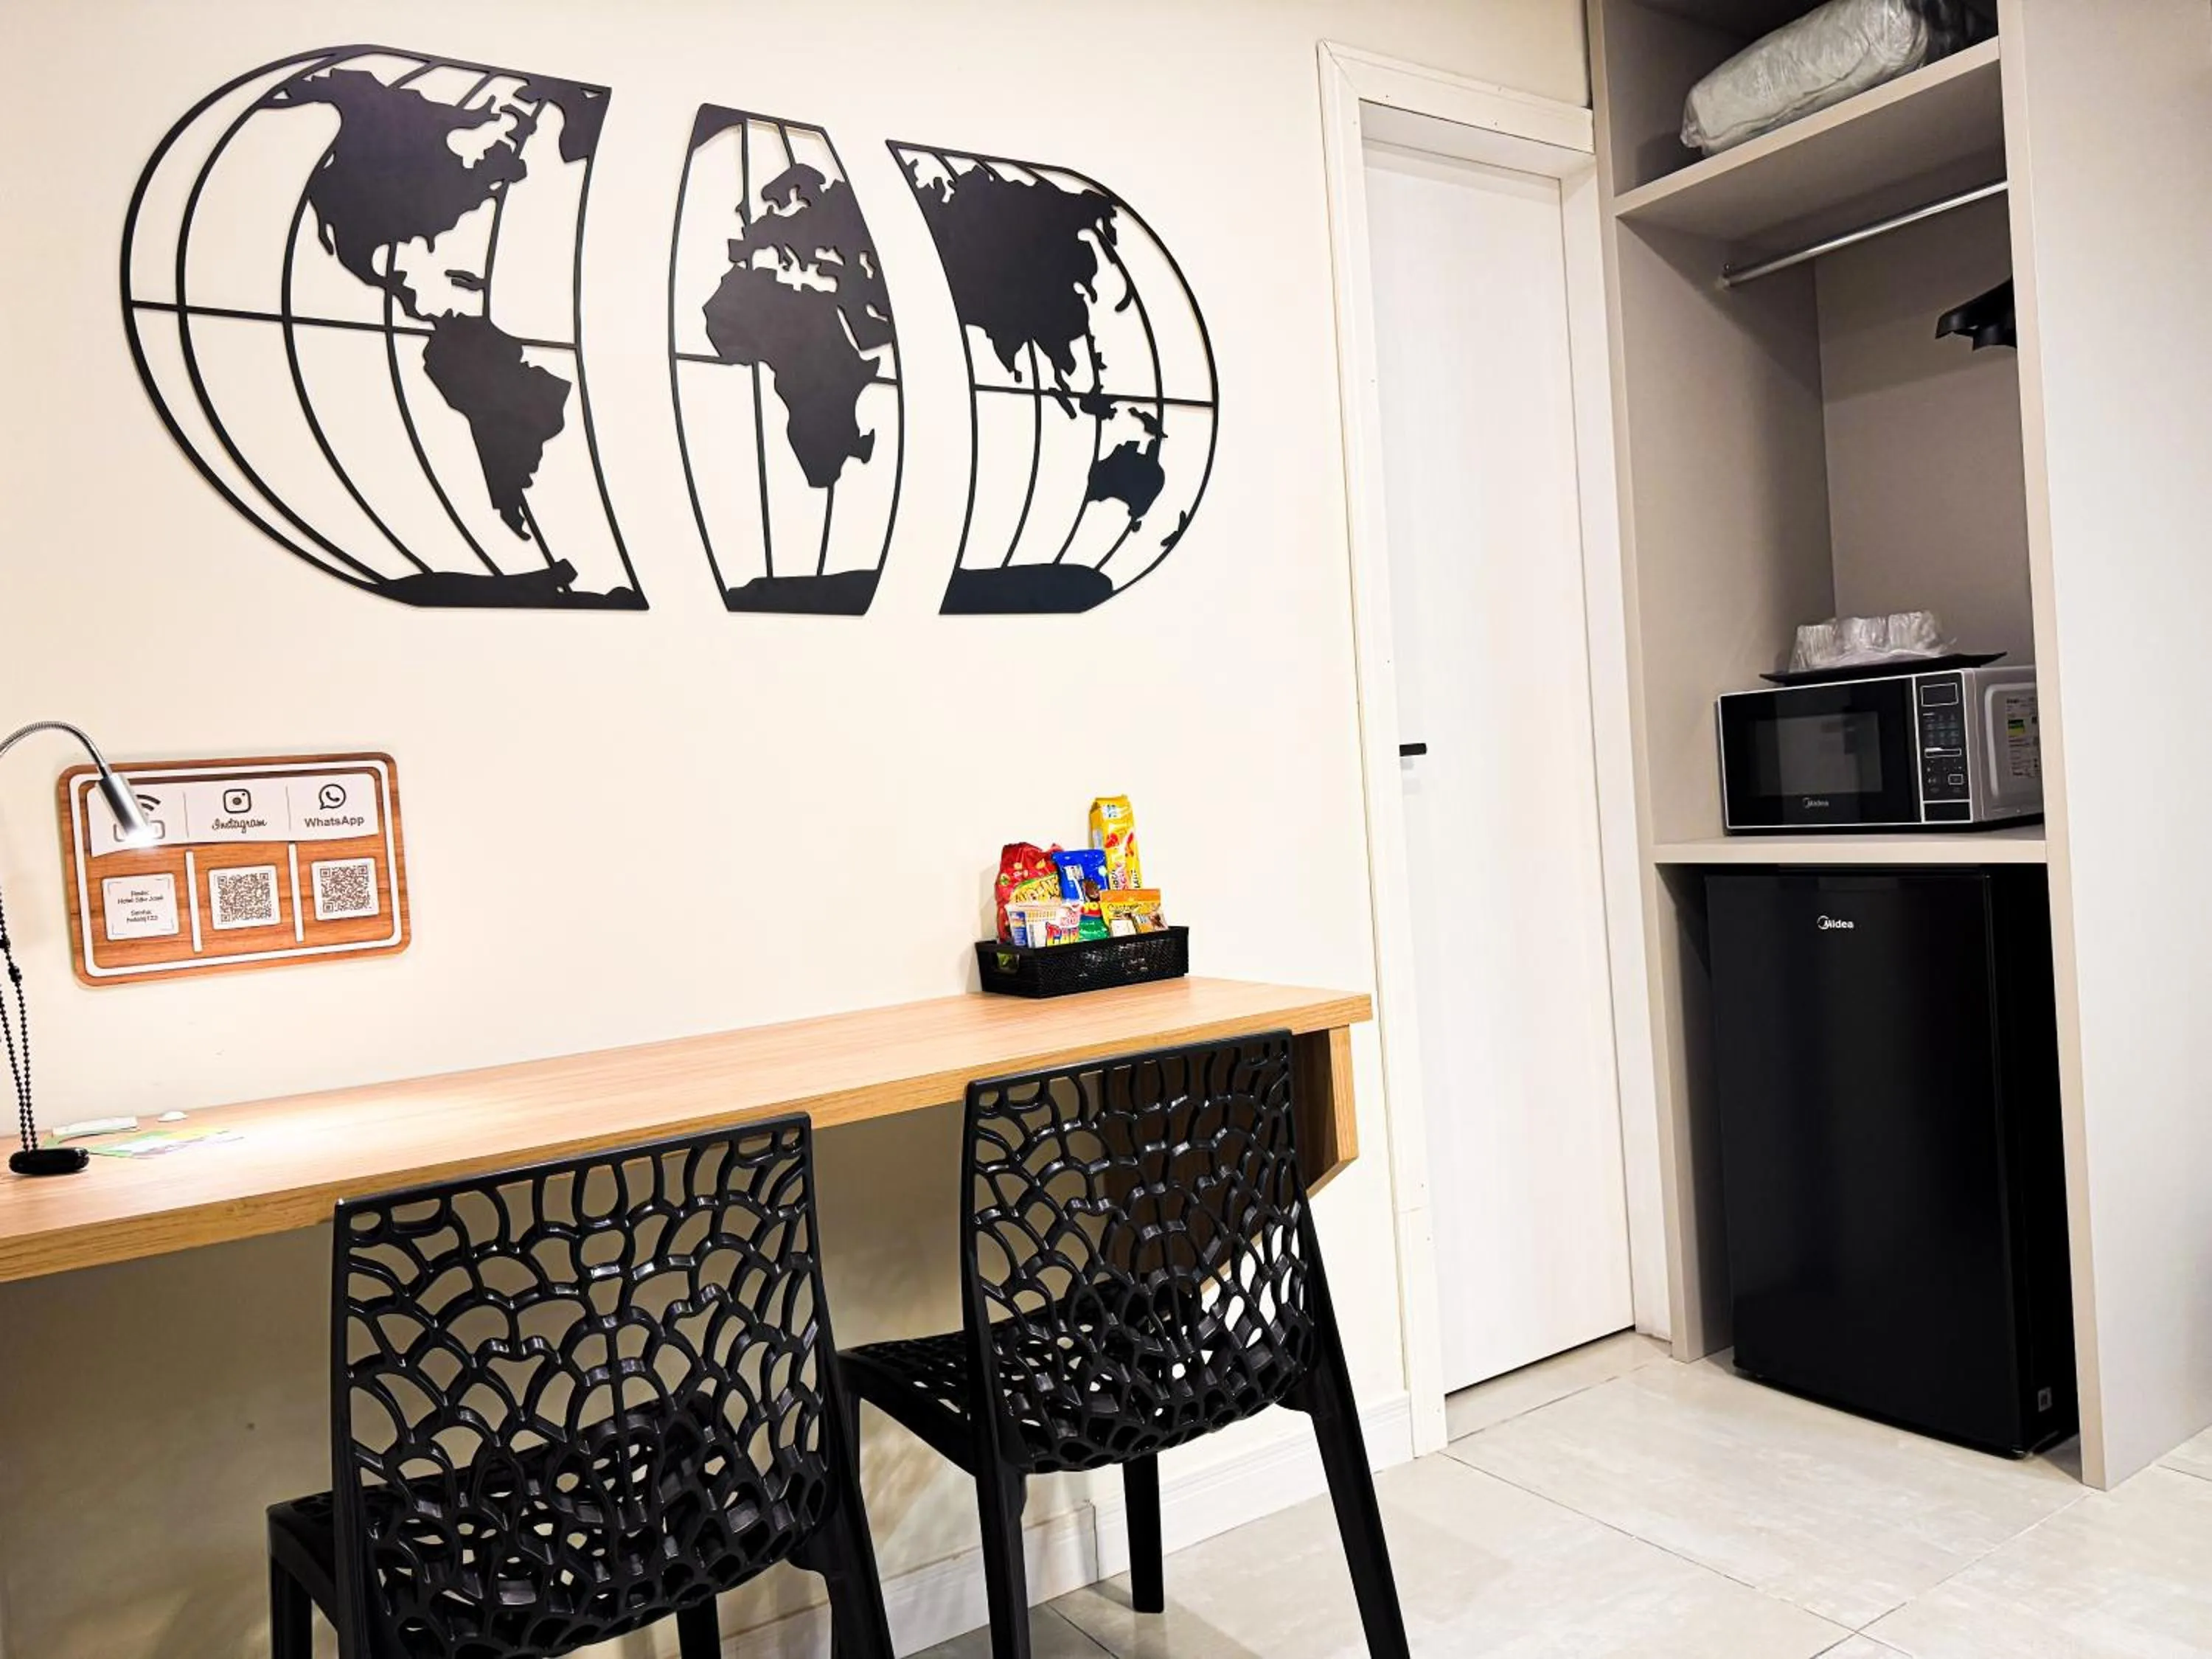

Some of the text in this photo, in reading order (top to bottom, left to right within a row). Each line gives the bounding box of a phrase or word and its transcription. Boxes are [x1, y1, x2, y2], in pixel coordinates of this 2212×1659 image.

[212, 818, 268, 834] Instagram
[304, 815, 365, 828] WhatsApp
[1816, 915, 1854, 930] Midea
